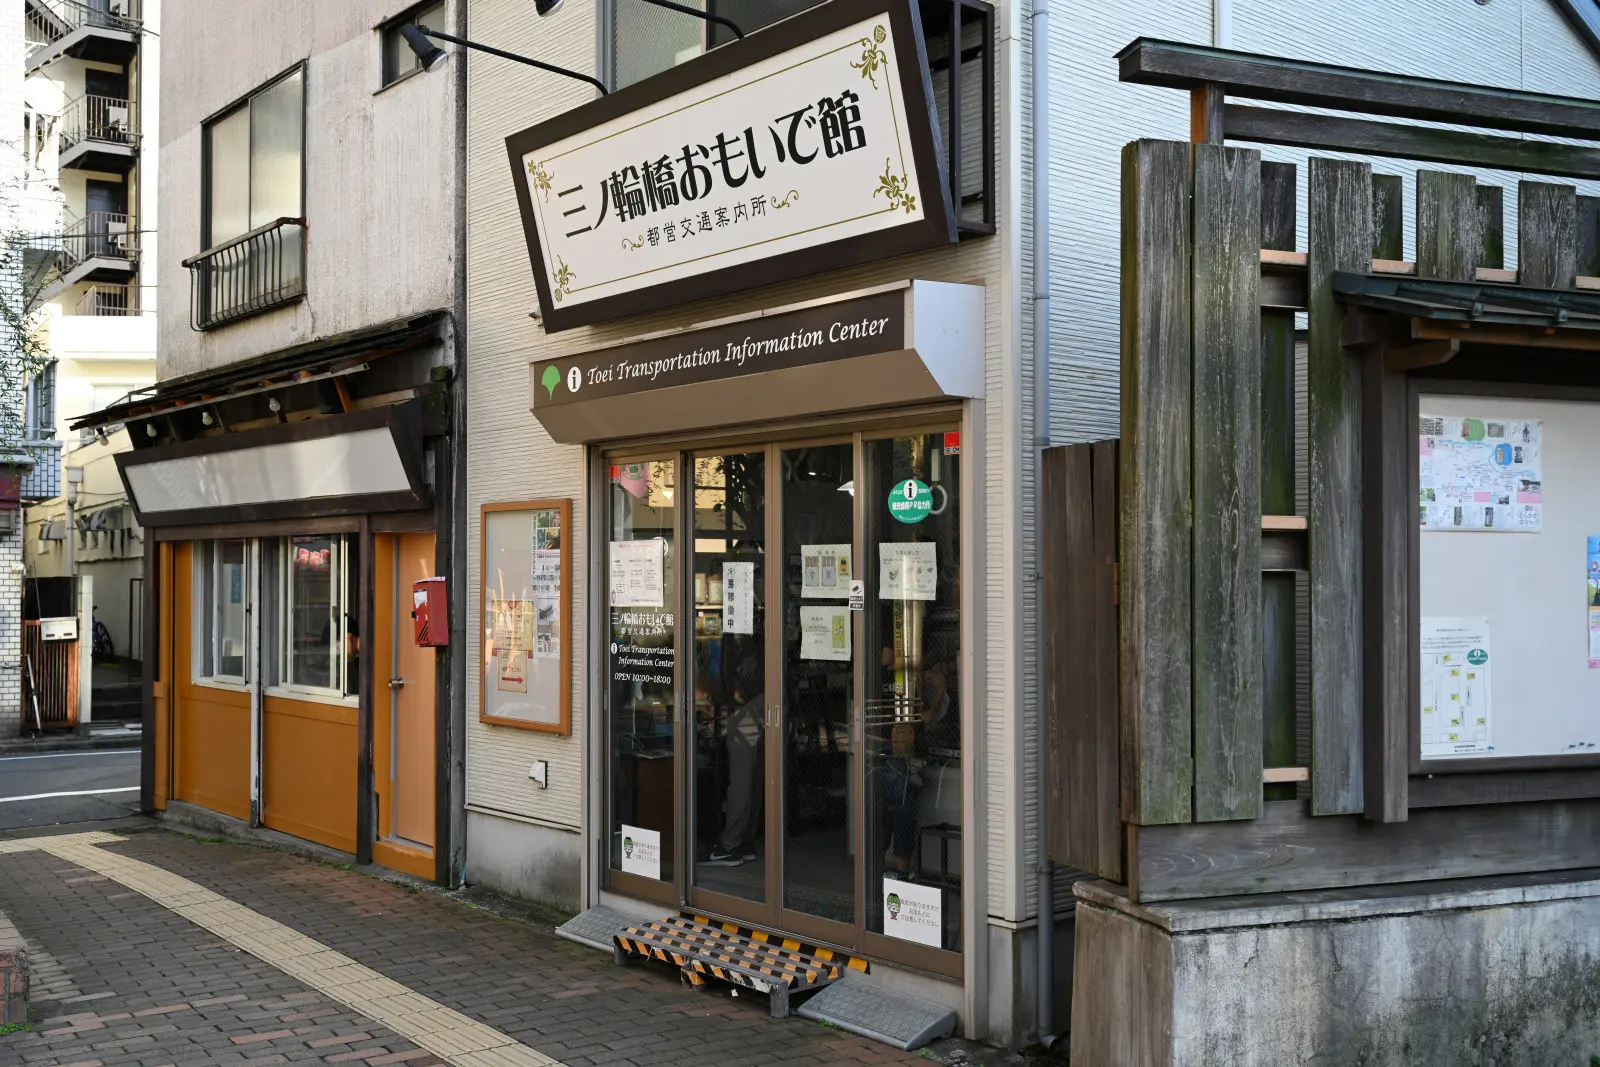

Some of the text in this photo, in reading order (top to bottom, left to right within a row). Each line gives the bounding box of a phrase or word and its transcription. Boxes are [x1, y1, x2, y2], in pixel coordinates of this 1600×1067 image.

[557, 88, 867, 238] 三ノ輪橋おもいで館
[646, 196, 768, 247] 都営交通案内所
[587, 364, 614, 385] Toei
[616, 347, 721, 380] Transportation
[725, 327, 824, 367] Information
[828, 315, 890, 343] Center
[618, 657, 653, 668] Information
[619, 645, 631, 653] Toei
[632, 645, 675, 656] Transportation
[614, 673, 631, 681] OPEN
